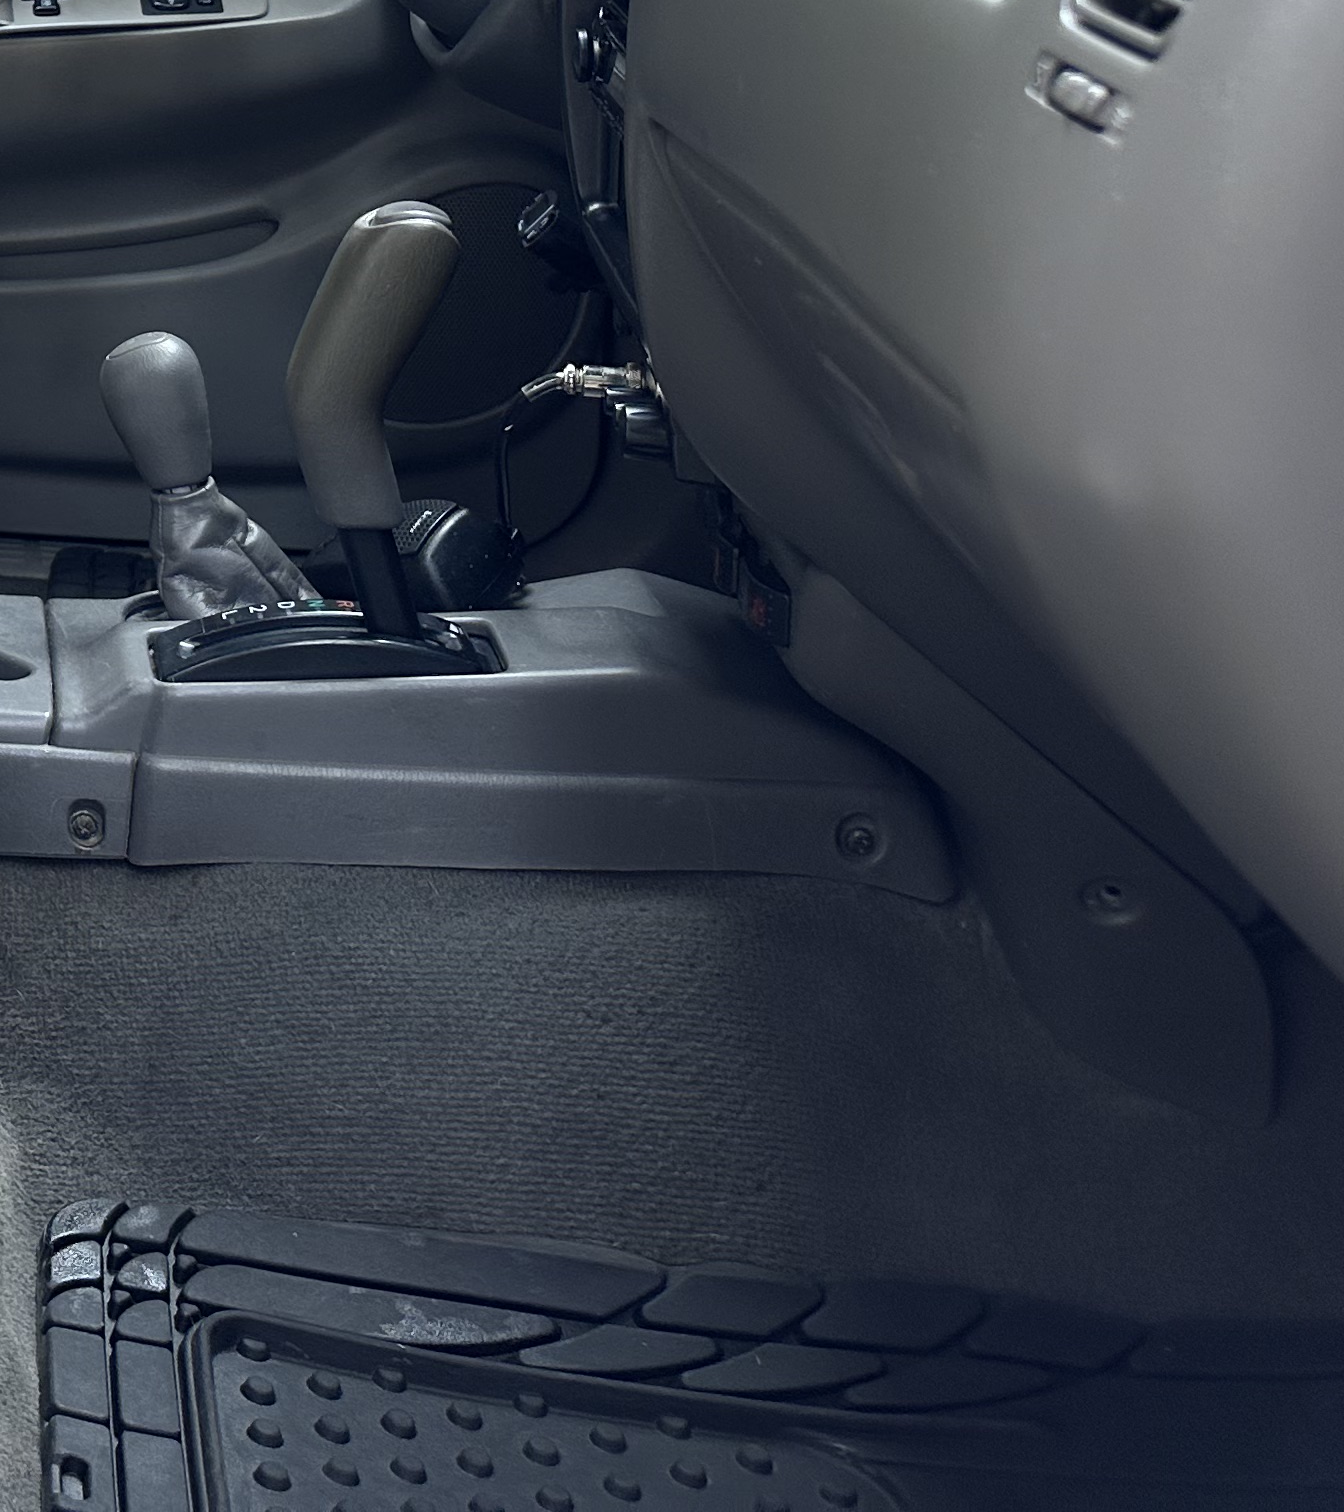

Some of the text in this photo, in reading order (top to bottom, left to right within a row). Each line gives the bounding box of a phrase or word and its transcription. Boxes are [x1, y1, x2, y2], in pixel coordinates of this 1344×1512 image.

[222, 610, 238, 619] L
[248, 604, 268, 614] 2
[277, 601, 296, 609] D
[307, 599, 326, 607] N
